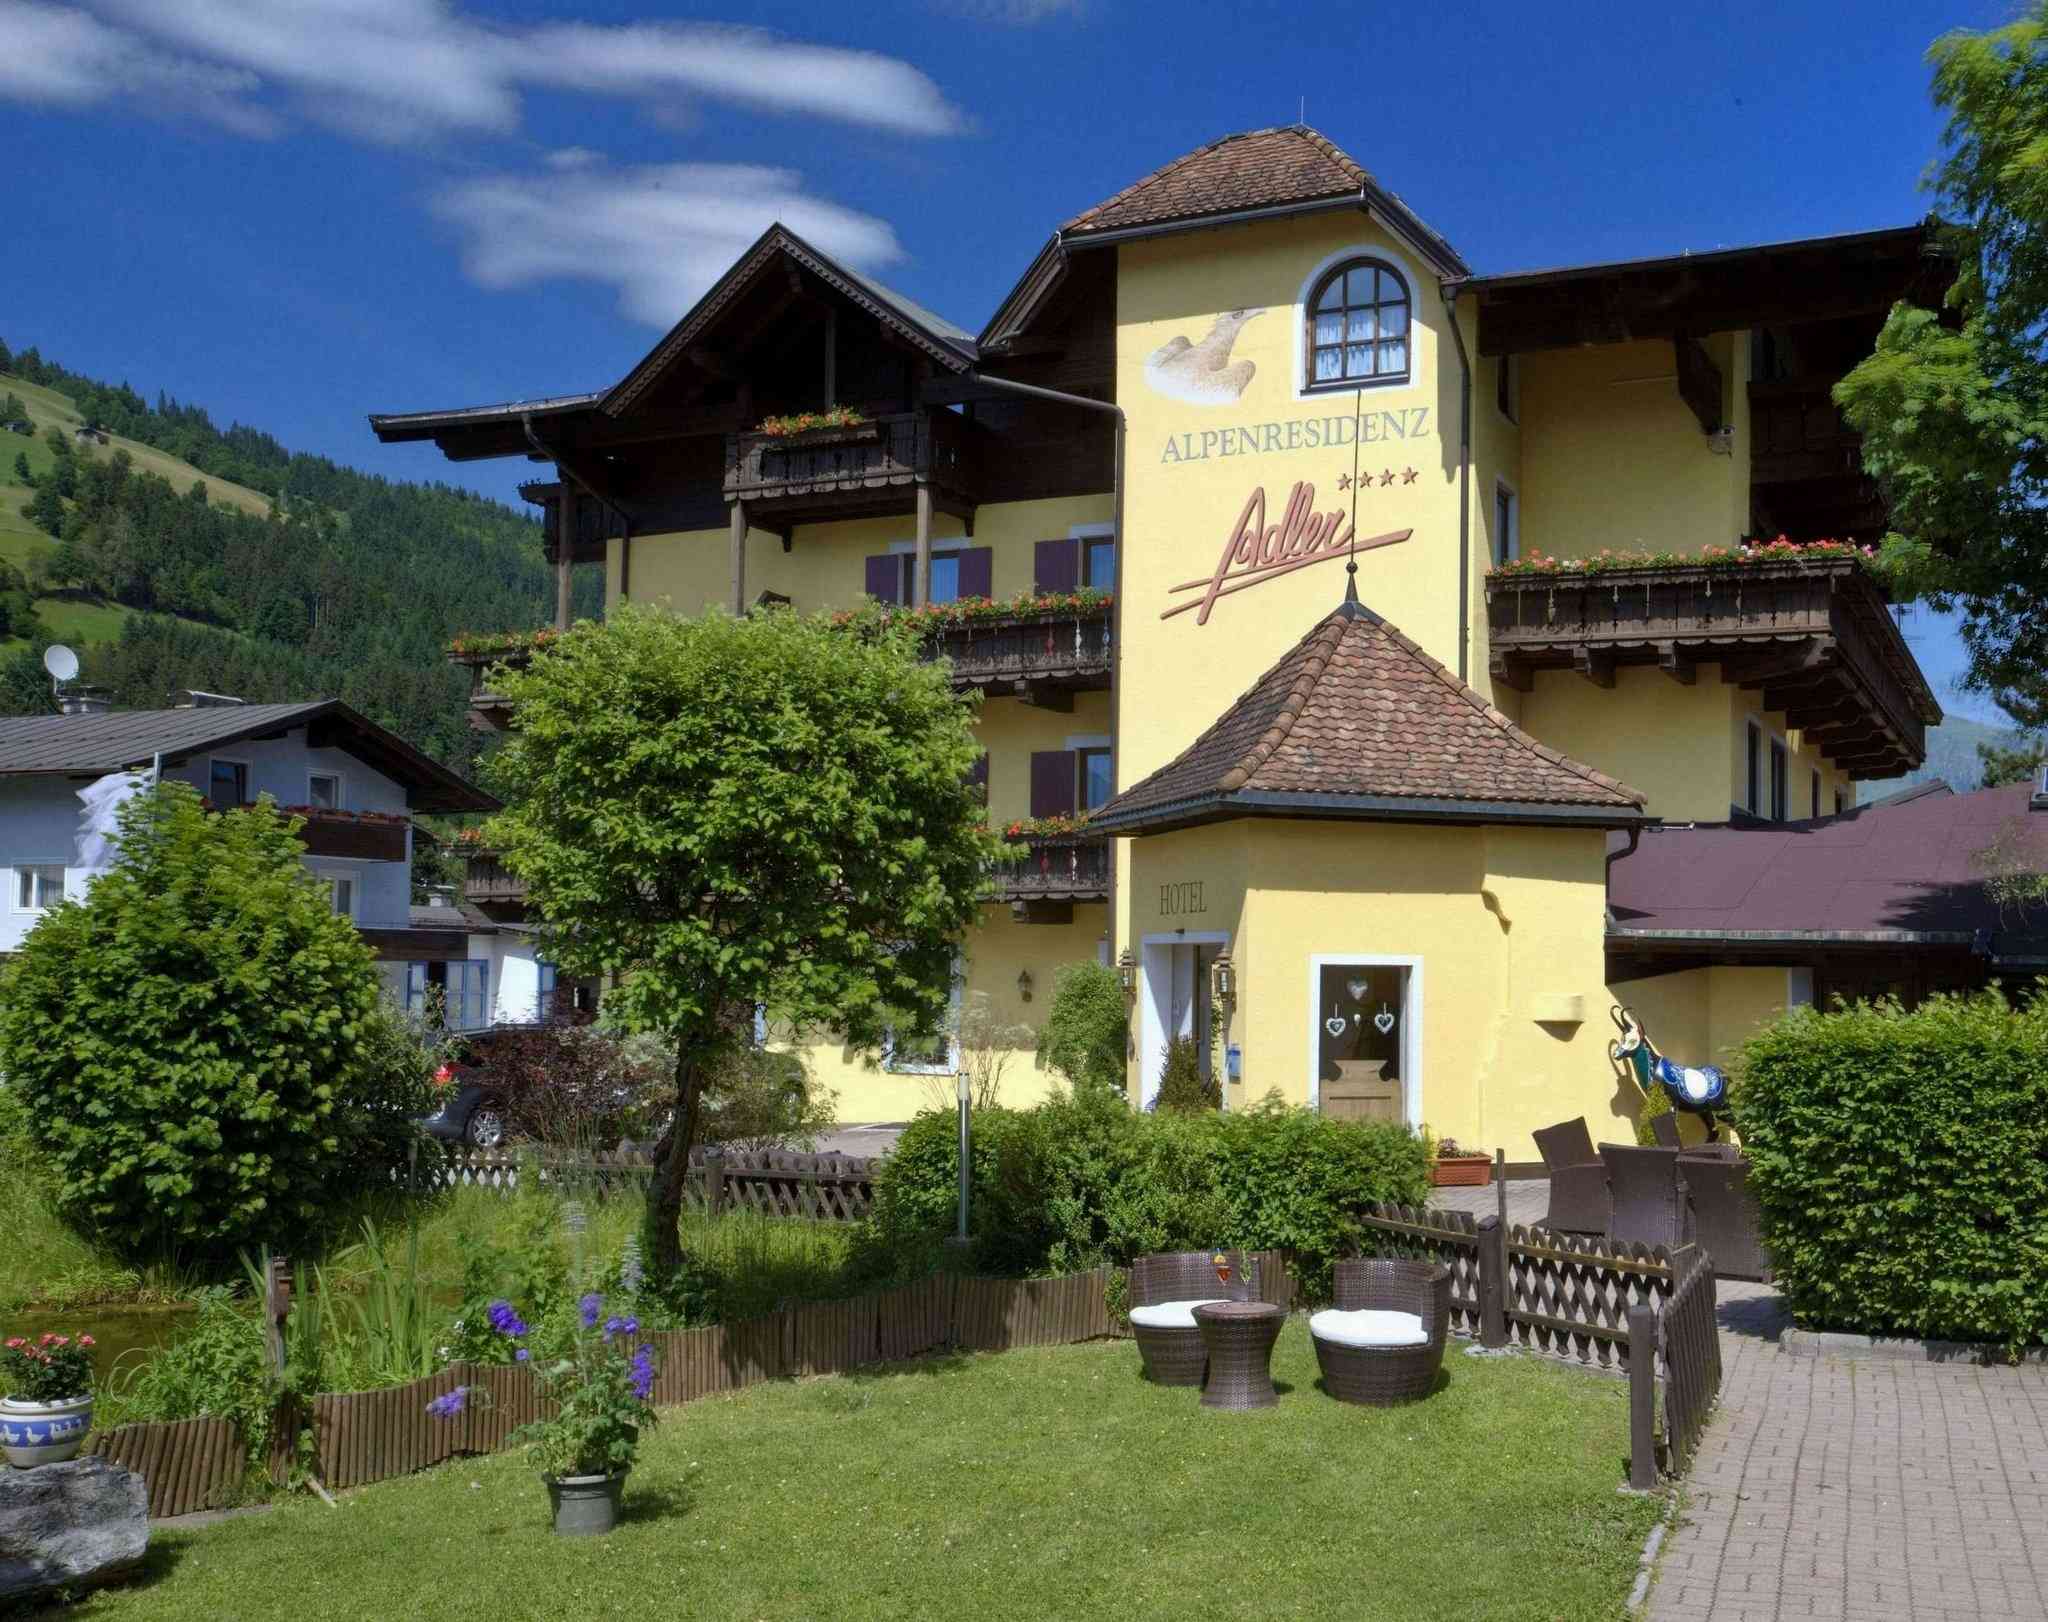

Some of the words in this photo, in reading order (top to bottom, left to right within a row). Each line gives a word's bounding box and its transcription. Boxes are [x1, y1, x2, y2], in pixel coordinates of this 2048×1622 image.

[1161, 408, 1429, 464] ALPENRESIDENZ
[1160, 481, 1414, 626] Adler
[1160, 882, 1208, 914] HOTEL
